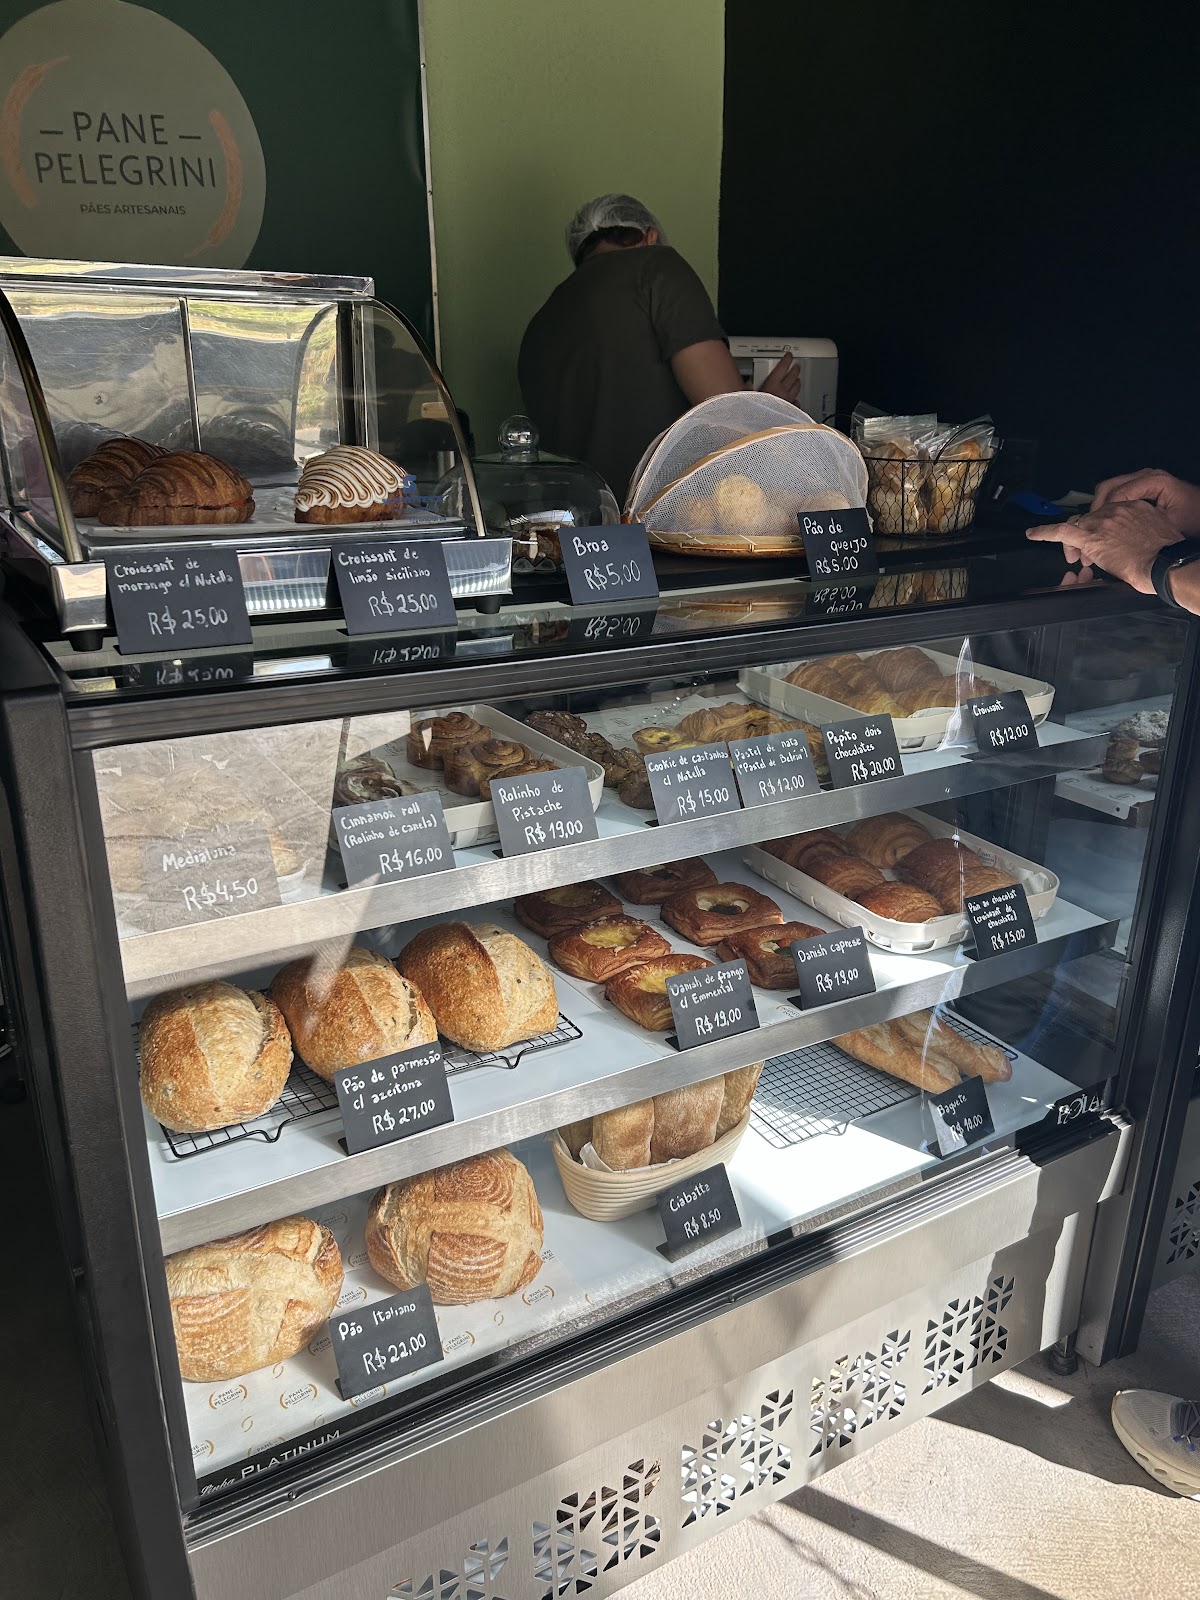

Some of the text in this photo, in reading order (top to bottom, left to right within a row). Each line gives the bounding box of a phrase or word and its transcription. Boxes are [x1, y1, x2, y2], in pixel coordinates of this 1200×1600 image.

[72, 111, 169, 145] PANE
[34, 152, 216, 188] PELEGRINI
[80, 202, 186, 215] PÃES ARTESANAIS
[803, 516, 844, 535] Pão de
[338, 548, 419, 566] Croissant de
[572, 536, 609, 556] Broa
[830, 537, 868, 557] queijo
[114, 557, 200, 578] Croissant de
[349, 566, 430, 584] limão siciliano
[118, 580, 172, 594] morango
[195, 570, 233, 587] Nutella
[972, 699, 1005, 717] Croissant
[826, 724, 882, 747] Pepito dois
[734, 738, 799, 761] Pastel de nata
[834, 742, 875, 760] chocolates
[648, 750, 729, 773] Cookie de castanhas
[768, 759, 777, 767] de
[677, 765, 707, 783] Nutella
[498, 780, 564, 804] Rolinho de
[340, 802, 421, 830] Cinnamon roll
[512, 799, 563, 822] Pistache
[344, 814, 437, 849] (Rolinho de canela)
[162, 845, 237, 872] Medialuna
[967, 901, 981, 913] Pain
[991, 888, 1018, 904] chocolat
[1005, 903, 1013, 913] de
[797, 938, 861, 963] Danish caprese
[705, 974, 715, 984] de
[717, 967, 744, 984] frango
[691, 980, 734, 1005] Emmental
[342, 1050, 441, 1095] Pão de parmesão
[371, 1079, 423, 1104] azeitona
[937, 1094, 968, 1117] Baguete
[669, 1182, 711, 1212] Ciabatta
[338, 1302, 417, 1341] Pão Italiano
[200, 1429, 340, 1496] Linha PLATINUM
